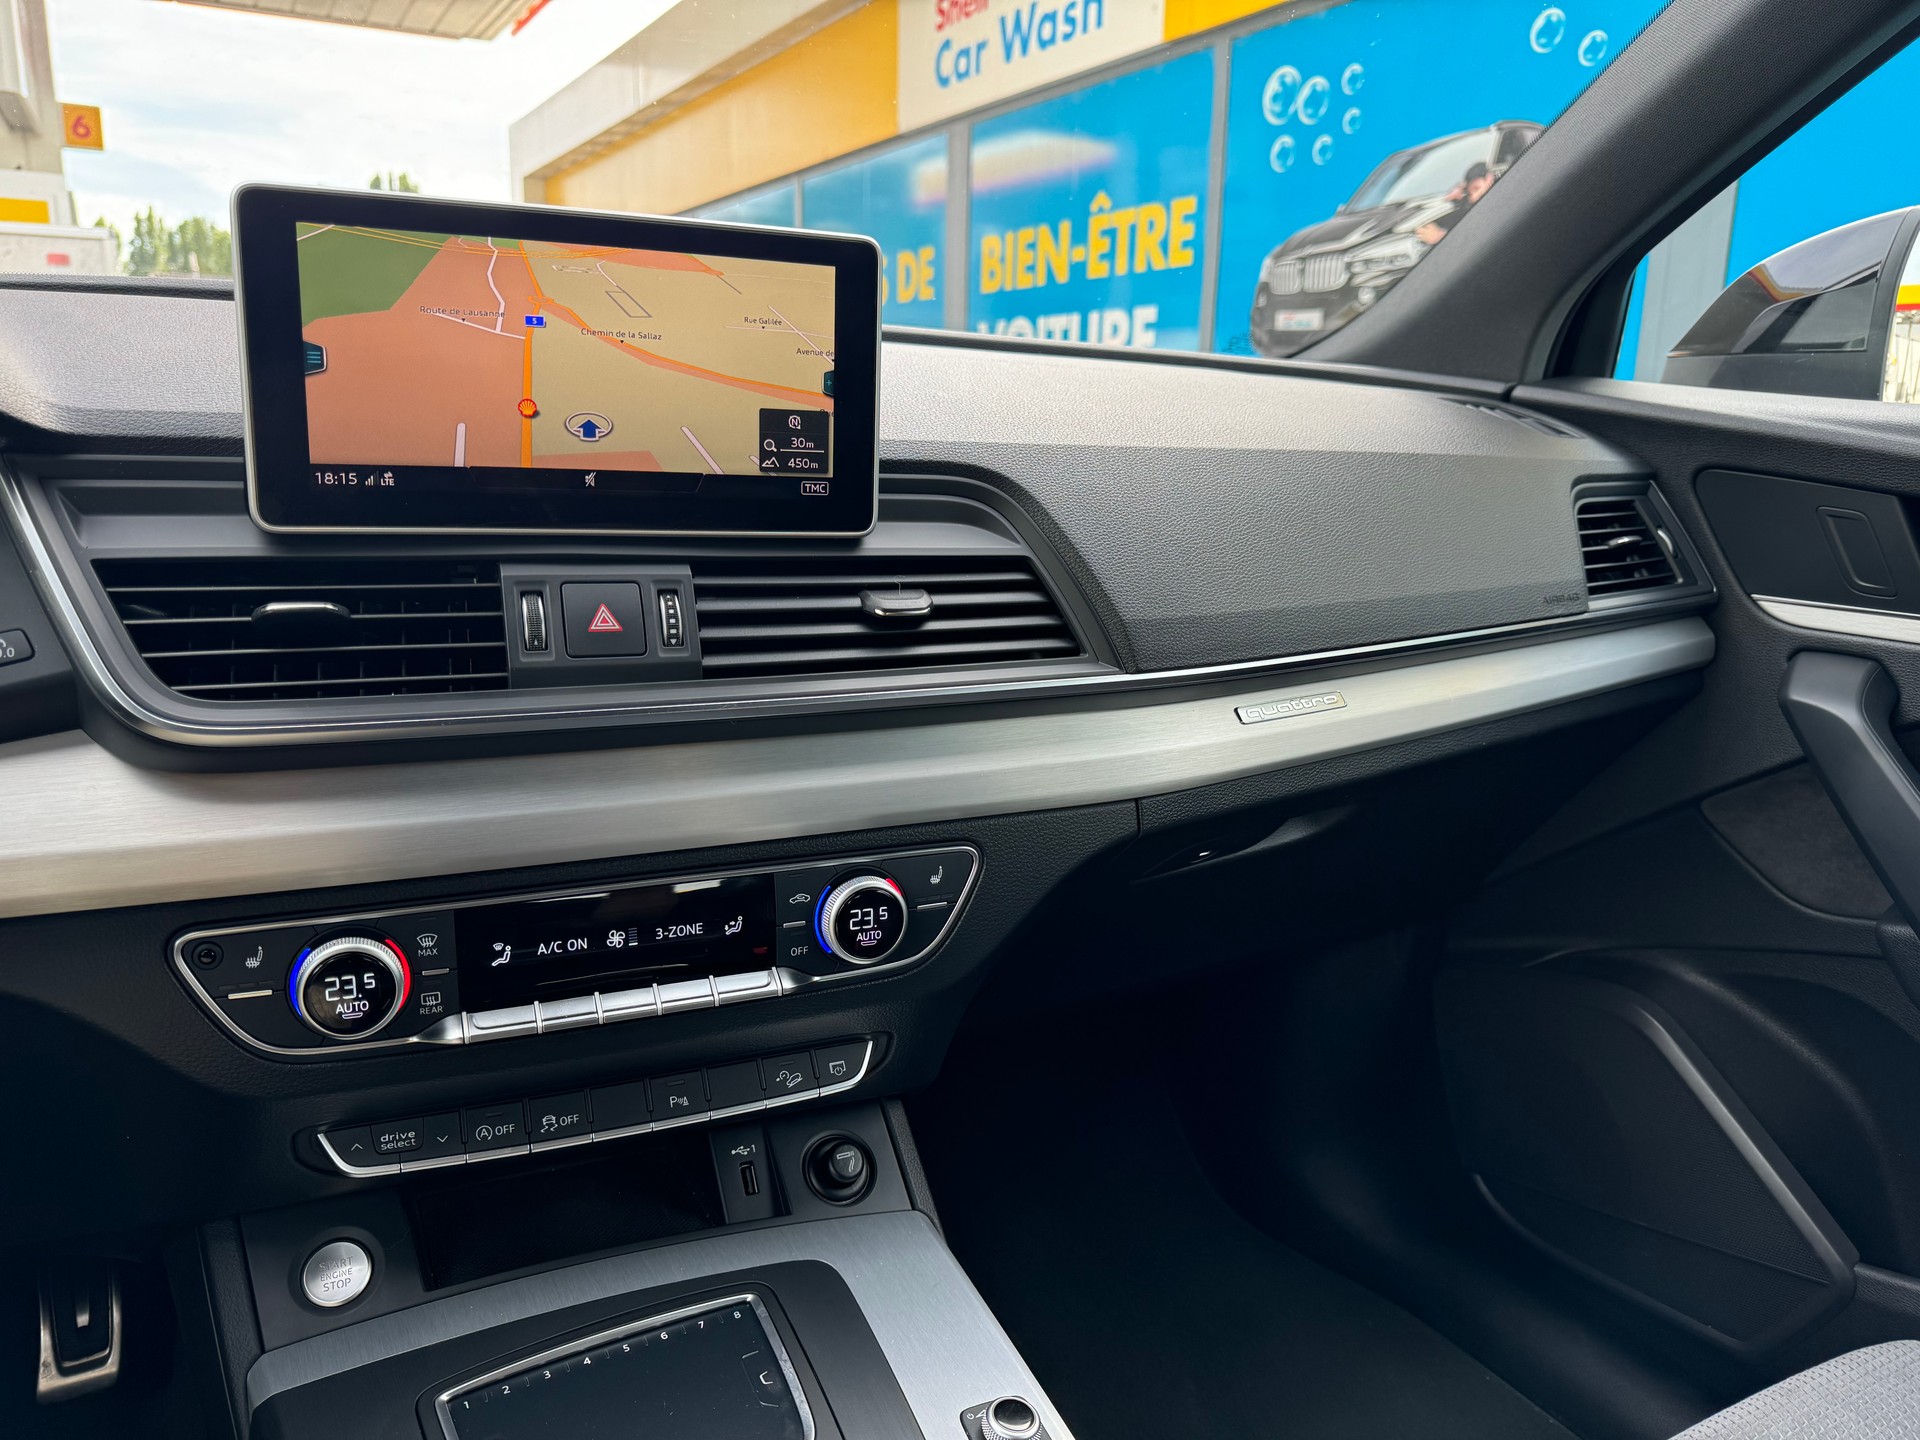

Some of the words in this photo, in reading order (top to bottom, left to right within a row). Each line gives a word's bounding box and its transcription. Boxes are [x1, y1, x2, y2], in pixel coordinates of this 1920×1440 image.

[935, 0, 990, 32] She
[935, 38, 988, 88] Car
[999, 0, 1104, 64] Wash
[72, 114, 91, 139] 6
[896, 245, 935, 304] DE
[980, 191, 1198, 295] BIEN-ÊTRE
[420, 305, 447, 315] Route
[450, 307, 460, 316] de
[463, 308, 506, 318] Lausanne
[744, 316, 757, 324] Rue
[581, 327, 614, 337] Chemin
[616, 330, 626, 338] de
[628, 331, 636, 339] la
[638, 331, 662, 341] Sallaz
[796, 347, 824, 357] Avenue
[315, 472, 358, 485] 18:15
[380, 478, 395, 486] LTE
[804, 483, 826, 493] TMC
[1246, 695, 1338, 720] quattro
[848, 906, 889, 931] 23.5
[655, 922, 704, 940] 3-ZONE
[856, 930, 882, 942] AUTO
[417, 947, 438, 957] MAX
[537, 940, 563, 956] A/C
[567, 938, 588, 951] ON
[790, 945, 809, 957] OFF
[324, 972, 377, 1002] 23.5
[335, 1000, 370, 1015] AUTO
[419, 1005, 443, 1016] REAR
[559, 1113, 580, 1126] OFF
[380, 1131, 416, 1142] drive
[495, 1123, 516, 1136] OFF
[380, 1138, 416, 1151] select
[319, 1255, 353, 1272] START
[320, 1267, 353, 1282] ENGINE
[323, 1277, 352, 1292] STOP
[463, 1400, 470, 1409] 1
[501, 1385, 511, 1395] 2
[543, 1370, 552, 1380] 3
[583, 1356, 592, 1365] 4
[622, 1343, 630, 1353] 5
[660, 1331, 669, 1340] 6
[697, 1320, 704, 1329] 7
[733, 1311, 742, 1319] 8
